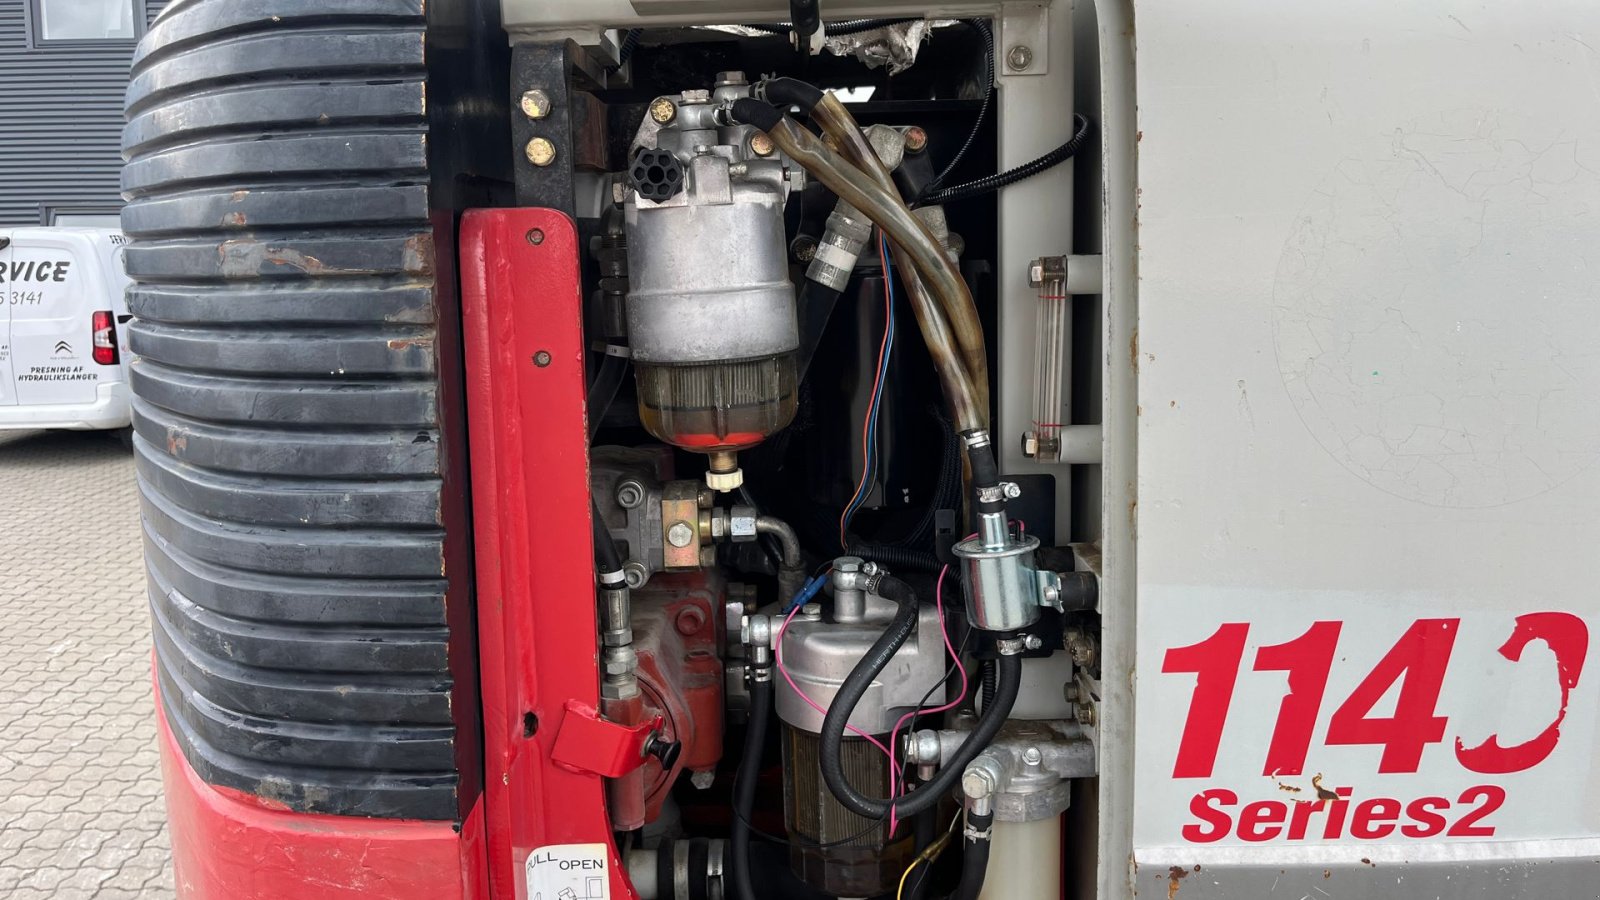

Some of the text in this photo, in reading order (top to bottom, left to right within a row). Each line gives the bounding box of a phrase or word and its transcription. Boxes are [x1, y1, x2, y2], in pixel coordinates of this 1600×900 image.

[10, 291, 42, 305] 3141
[30, 365, 84, 374] PRESNING AF
[18, 373, 98, 382] HYDRAULIKSLANGER
[1181, 784, 1506, 844] Series2
[559, 859, 603, 871] OPEN
